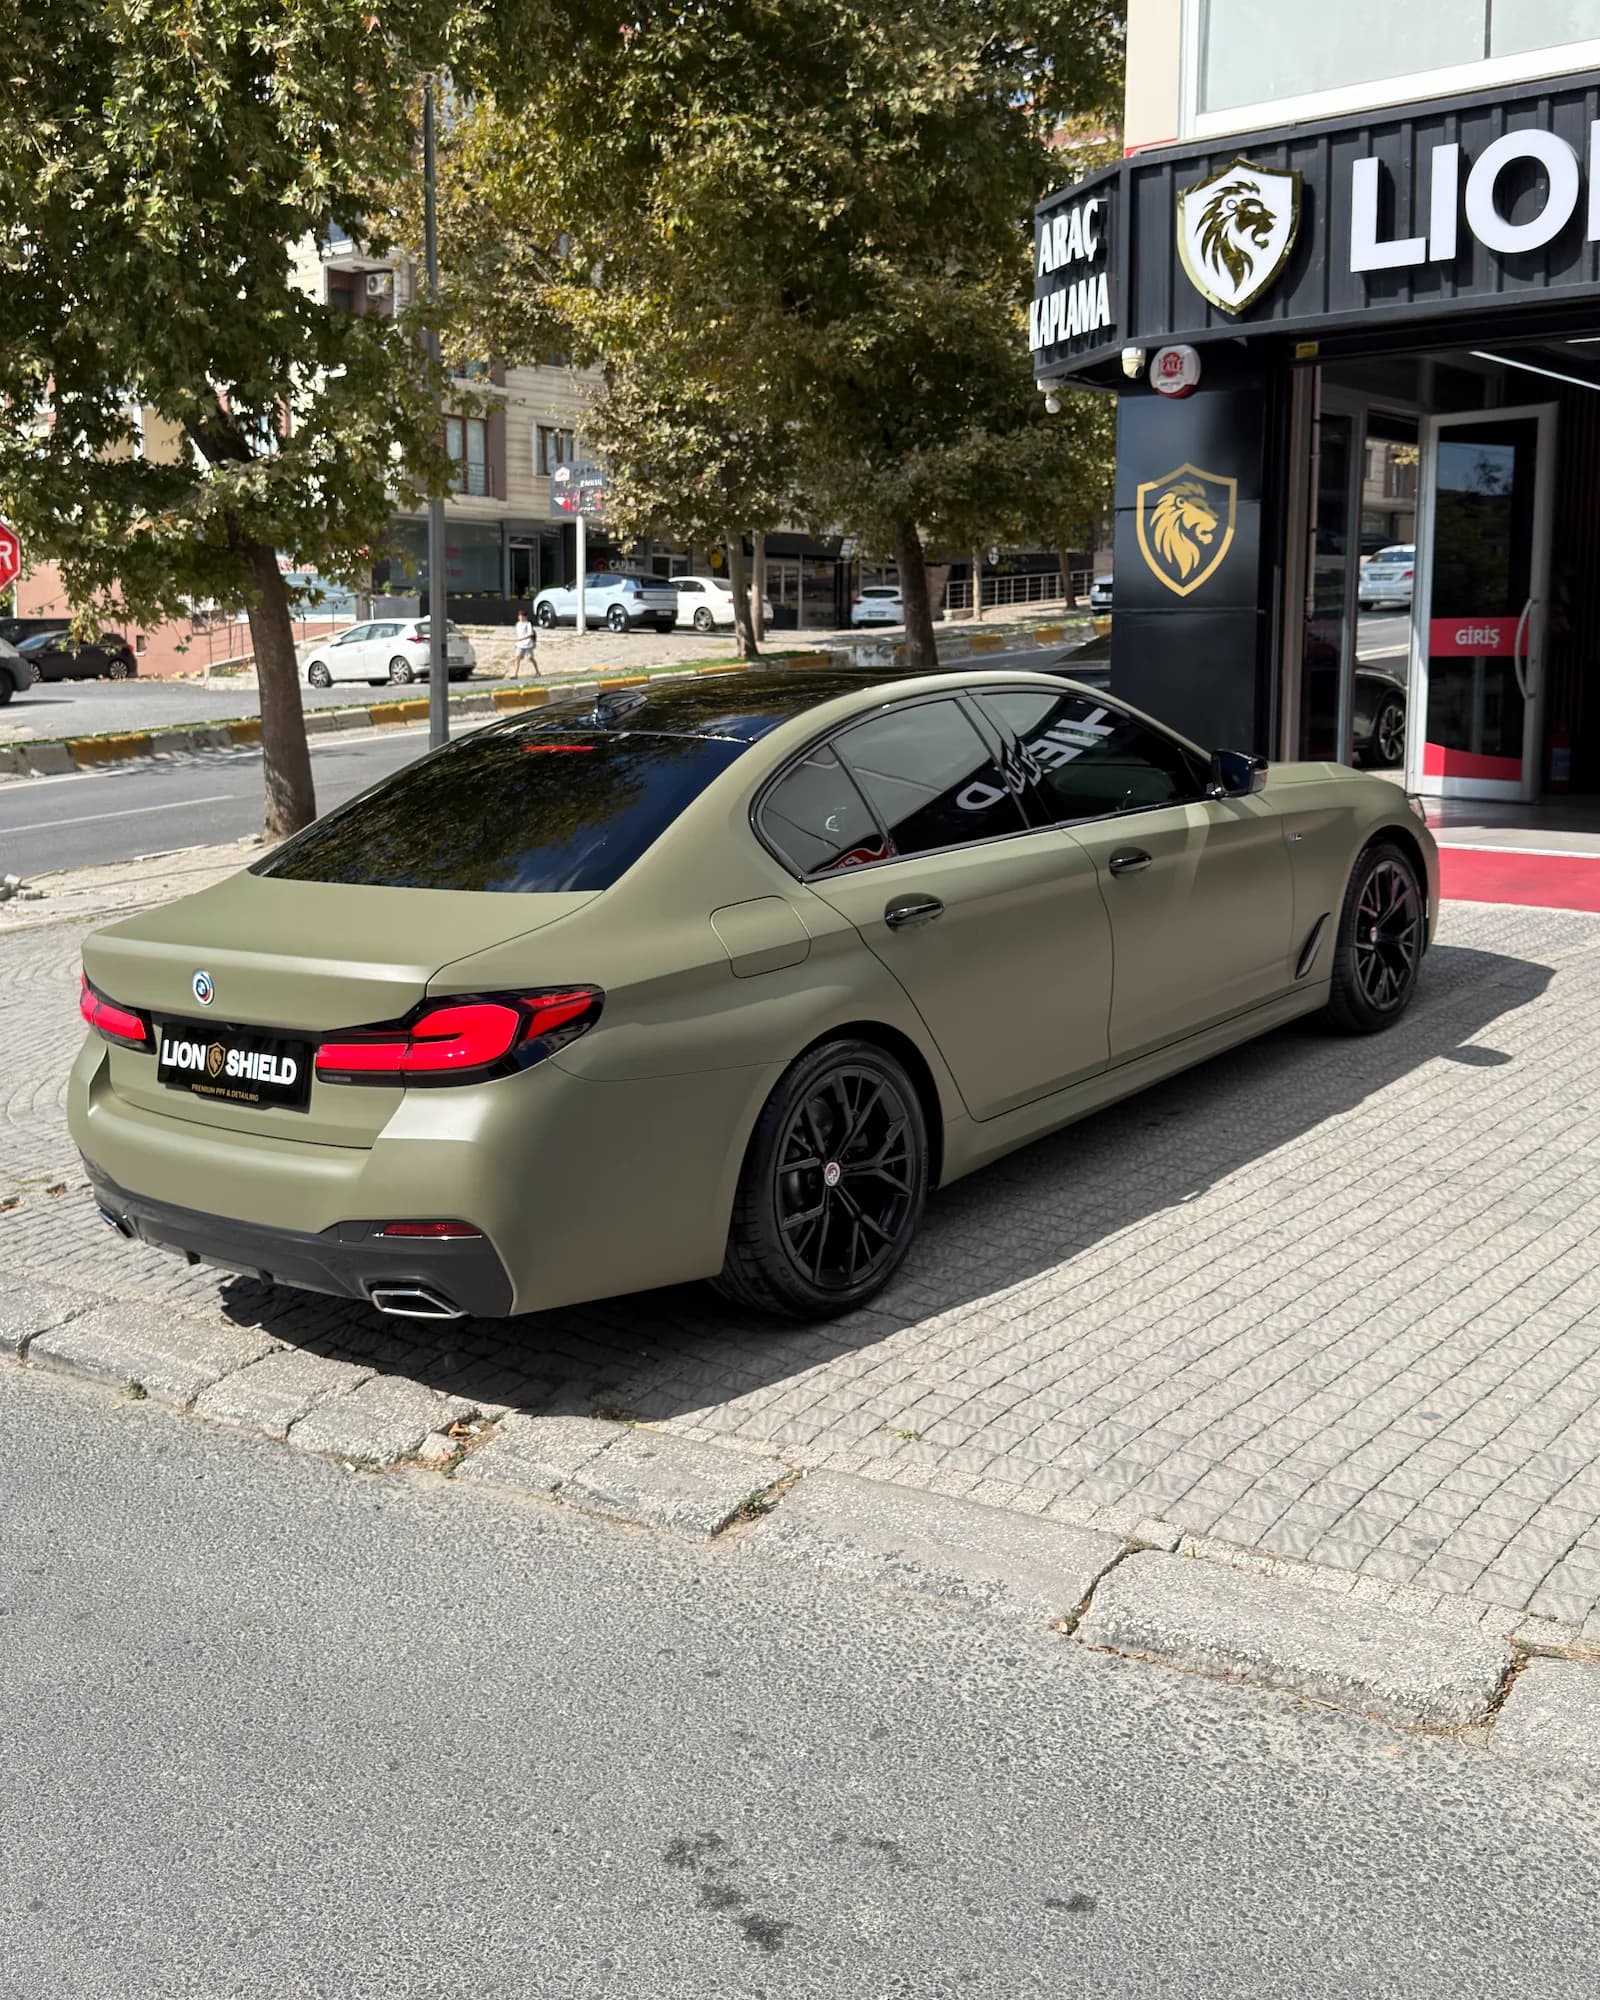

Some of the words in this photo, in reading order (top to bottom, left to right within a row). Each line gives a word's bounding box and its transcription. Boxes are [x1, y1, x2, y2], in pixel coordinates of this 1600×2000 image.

[1350, 120, 1600, 272] LIO
[1037, 198, 1099, 277] ARAÇ
[1029, 272, 1111, 352] KAPLAMA
[1455, 625, 1500, 648] GİRİŞ
[162, 1039, 206, 1071] LION
[225, 1049, 297, 1085] SHIELD
[191, 1083, 216, 1094] PREMIUM
[215, 1087, 225, 1096] PPF
[231, 1090, 259, 1102] DETAILING
